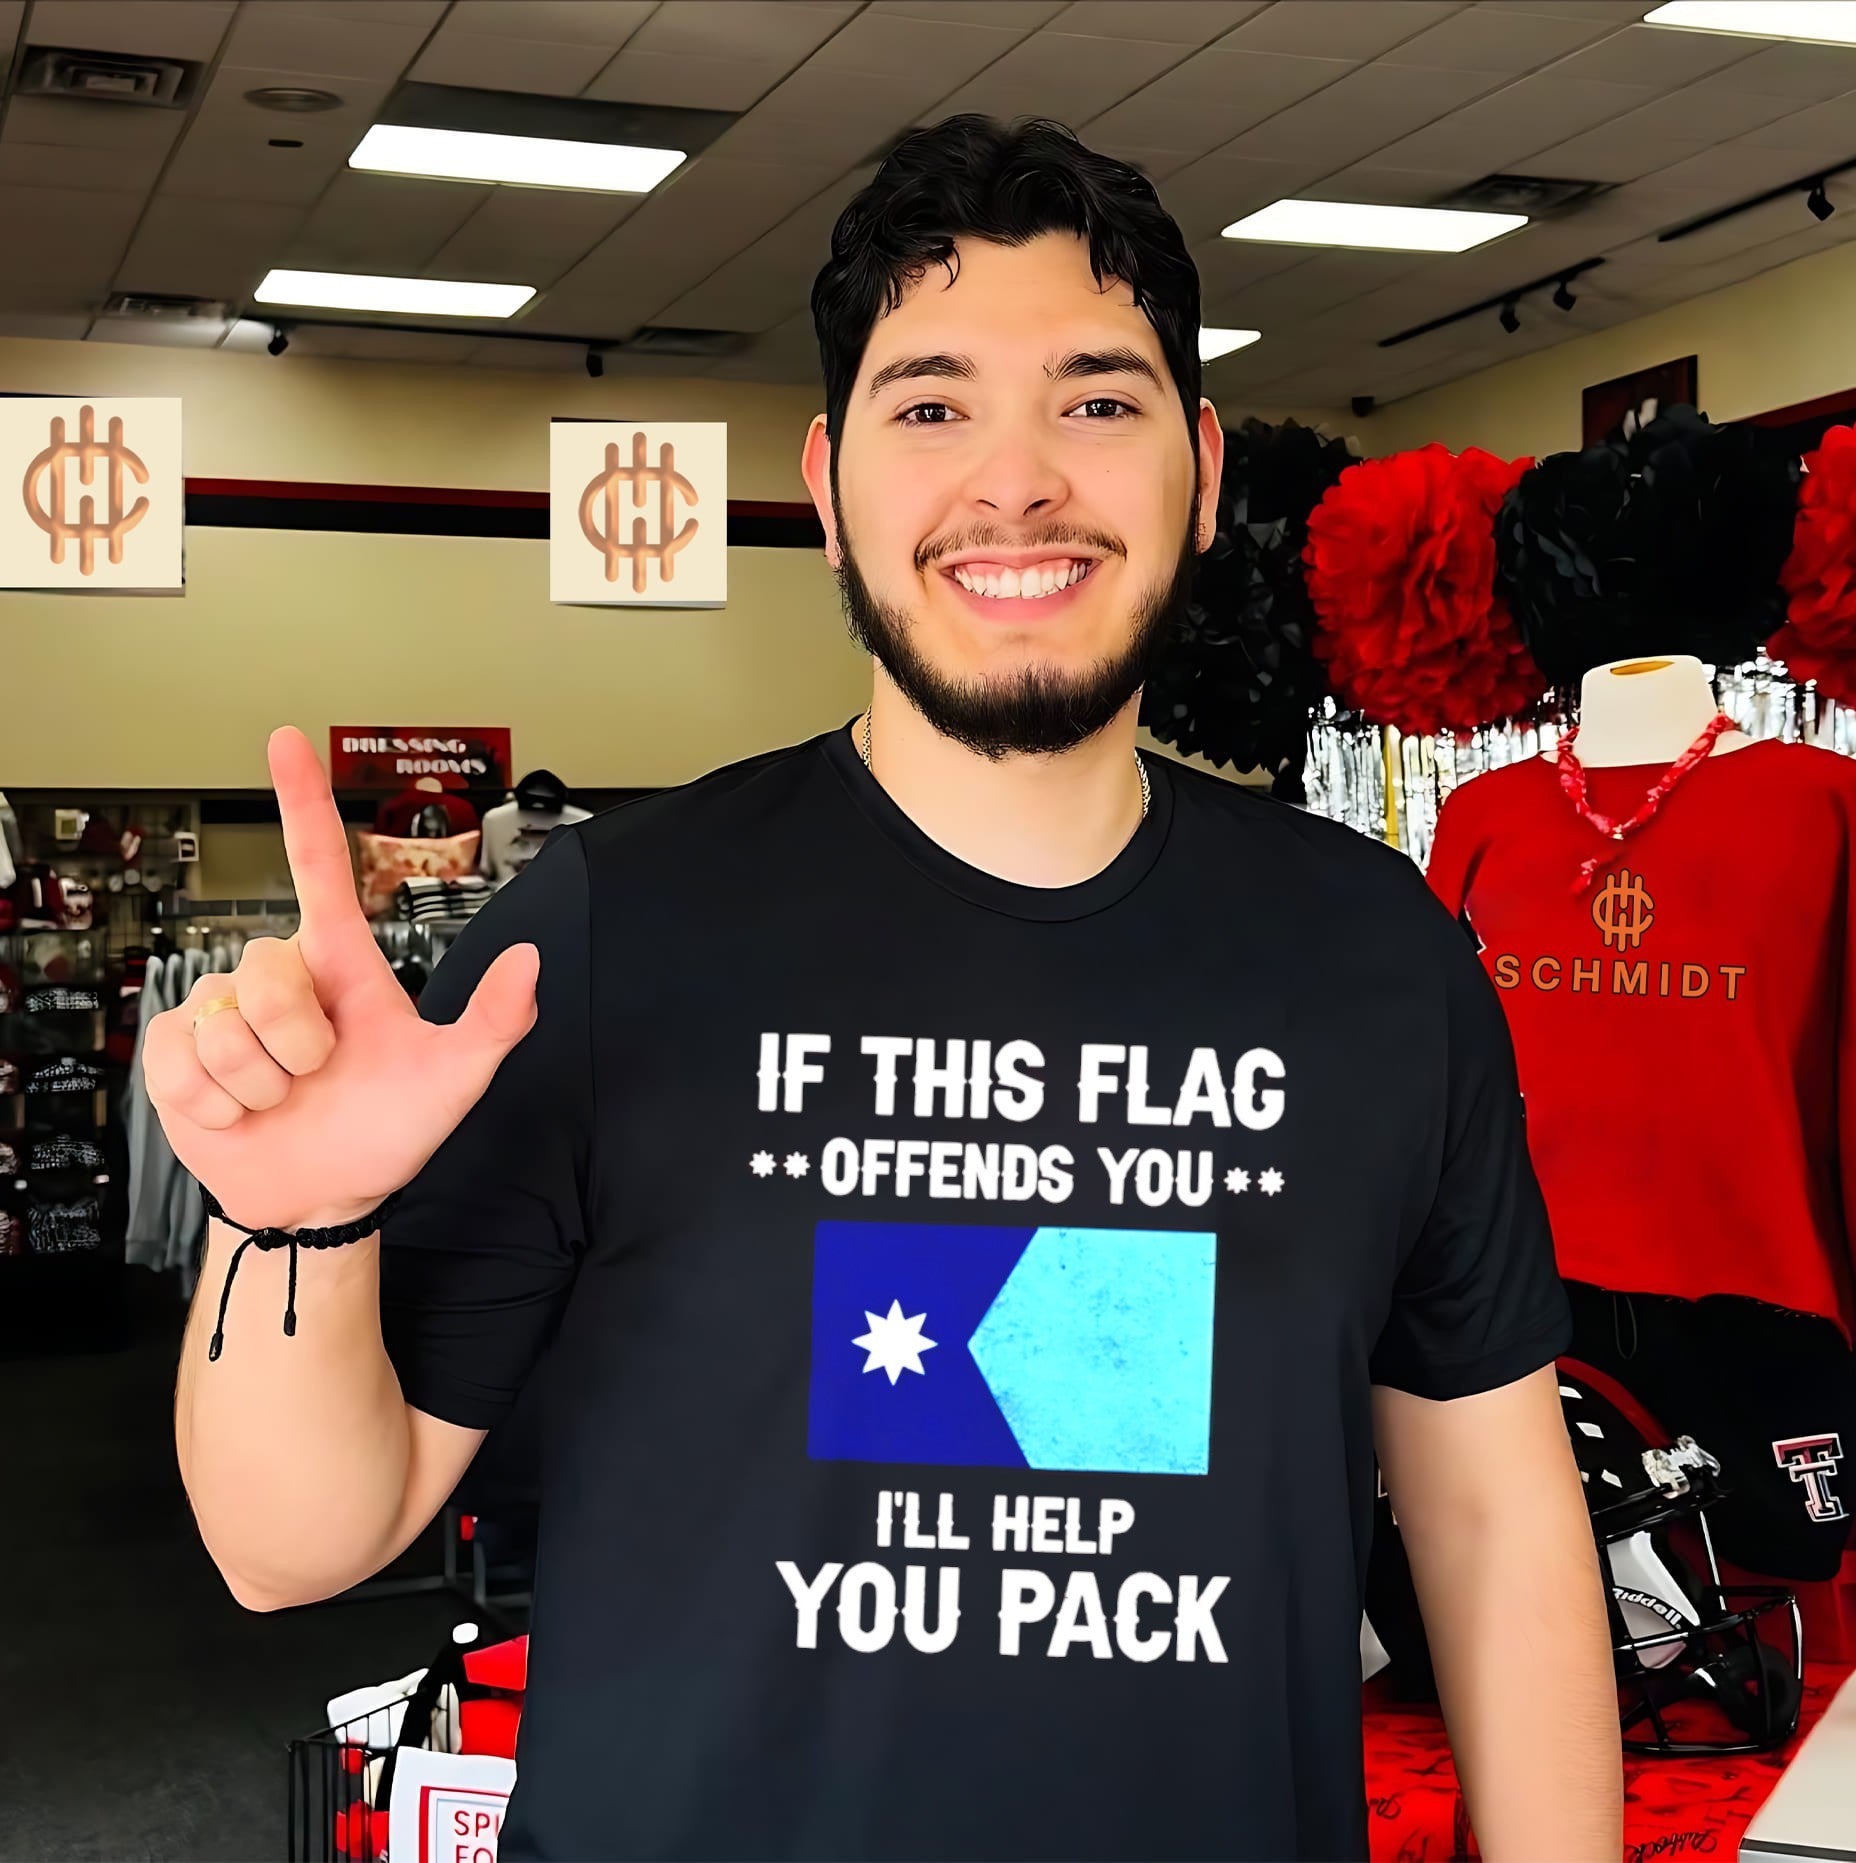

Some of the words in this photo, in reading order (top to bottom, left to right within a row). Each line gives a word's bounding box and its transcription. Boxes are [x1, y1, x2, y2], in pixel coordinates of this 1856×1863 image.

[396, 759, 487, 775] ROOMS
[1494, 953, 1747, 1000] SCHMIDT
[756, 1032, 832, 1113] IF
[860, 1035, 1046, 1122] THIS
[1076, 1043, 1286, 1131] FLAG
[820, 1136, 1075, 1204] OFFENDS
[1096, 1146, 1214, 1207] YOU
[876, 1490, 971, 1551] I'LL
[991, 1494, 1136, 1555] HELP
[775, 1560, 962, 1654] YOU
[997, 1568, 1232, 1664] PACK
[1611, 1587, 1682, 1627] Riddell
